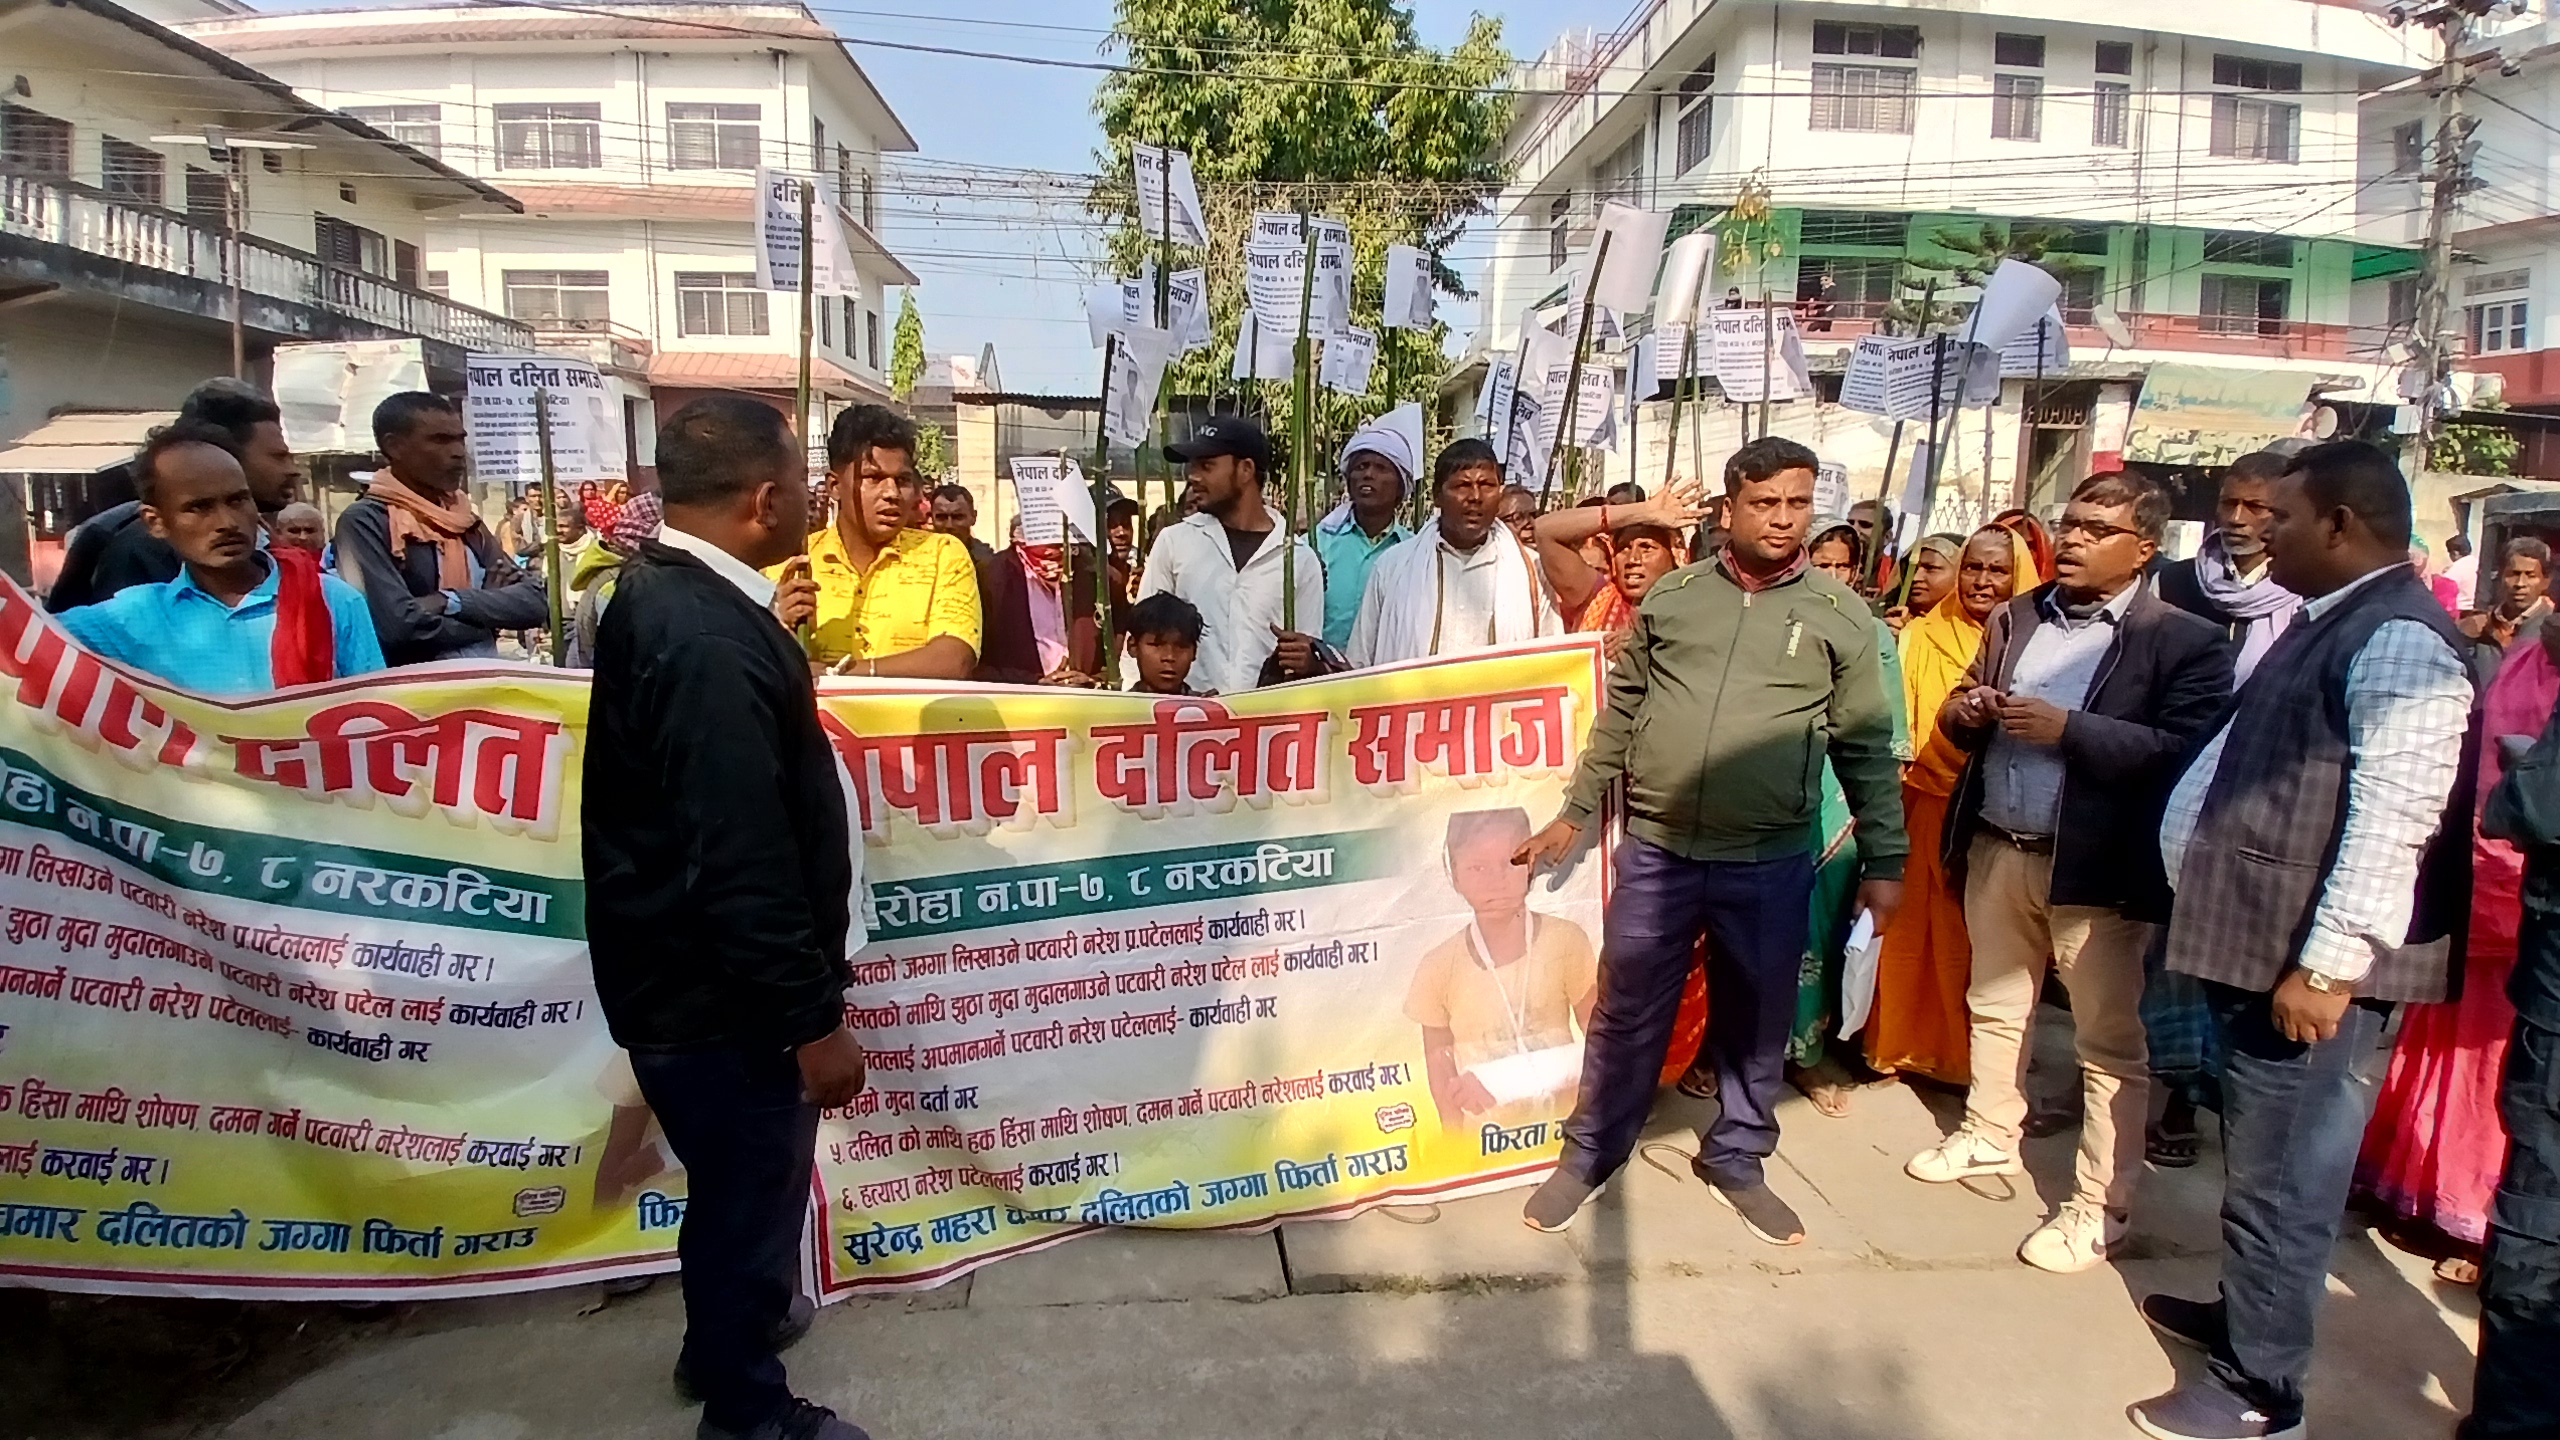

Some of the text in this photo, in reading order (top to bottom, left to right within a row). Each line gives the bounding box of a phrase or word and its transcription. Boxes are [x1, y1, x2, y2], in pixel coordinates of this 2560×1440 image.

[1248, 249, 1279, 269] नेपाल
[1259, 218, 1288, 236] नेपाल
[1714, 316, 1741, 334] नेपाल
[1887, 344, 1919, 364] नेपाल
[508, 362, 560, 387] दलित
[1016, 463, 1048, 481] नेपाल
[216, 701, 561, 821] दलित
[1090, 699, 1329, 806] दलित
[1347, 686, 1568, 785] समाज
[26, 843, 114, 894] लिखाउने
[120, 878, 177, 920] पटवारी
[182, 905, 227, 941] नरेश
[351, 939, 445, 979] कार्यवाही
[447, 952, 483, 982] गर
[260, 856, 297, 889] ८
[311, 860, 552, 924] नरकटिया
[875, 886, 963, 927] रोहा
[1128, 866, 1150, 897] ८
[1163, 844, 1335, 891] नरकटिया
[6, 907, 54, 944] झुठा
[56, 916, 101, 952] मुदा
[105, 923, 213, 972] मुदालगाउने
[219, 959, 283, 998] पटवारी
[288, 980, 338, 1011] नरेश
[344, 988, 396, 1019] पटेल
[401, 996, 445, 1025] लाई
[449, 999, 537, 1029] कार्यवाही
[541, 1000, 570, 1024] गर
[902, 953, 947, 980] जग्गा
[952, 939, 1020, 973] लिखाउने
[1025, 930, 1078, 961] पटवारी
[1082, 927, 1120, 955] नरेश
[1208, 908, 1269, 940] कार्यवाही
[1274, 909, 1296, 932] गर
[70, 976, 145, 1012] पटवारी
[149, 982, 203, 1019] नरेश
[307, 1026, 393, 1062] कार्यवाही
[397, 1039, 432, 1062] गर
[844, 1000, 901, 1030] लितको
[906, 993, 946, 1025] माथि
[951, 993, 983, 1024] झुठा
[988, 988, 1019, 1018] मुदा
[1024, 971, 1110, 1013] मुदालगाउने
[1115, 963, 1165, 995] पटवारी
[1170, 960, 1207, 987] नरेश
[1212, 955, 1246, 983] पटेल
[1250, 948, 1280, 979] लाई
[1284, 939, 1343, 972] कार्यवाही
[1347, 942, 1369, 965] गर
[921, 1029, 1006, 1071] अपमानगर्ने
[1011, 1020, 1063, 1053] पटवारी
[1068, 1016, 1106, 1044] नरेश
[1189, 995, 1250, 1028] कार्यवाही
[1256, 996, 1277, 1018] गर
[18, 1078, 72, 1120] हिंसा
[75, 1087, 131, 1124] माथि
[209, 1105, 263, 1134] दमन
[266, 1108, 302, 1140] गर्ने
[304, 1118, 373, 1153] पटवारी
[374, 1124, 468, 1167] नरेशलाई
[466, 1136, 536, 1171] करवाई
[537, 1144, 570, 1168] गर
[846, 1130, 893, 1162] दलित
[898, 1125, 920, 1152] को
[925, 1125, 963, 1151] माथि
[967, 1128, 995, 1154] हक
[1000, 1117, 1035, 1149] हिंसा
[1040, 1107, 1079, 1139] माथि
[1136, 1098, 1173, 1125] दमन
[1178, 1089, 1203, 1118] गर्ने
[1208, 1081, 1257, 1113] पटवारी
[1261, 1070, 1324, 1105] नरेशलाई
[1328, 1062, 1375, 1095] करवाई
[1379, 1065, 1401, 1086] गर
[884, 1090, 915, 1117] मुदा
[919, 1084, 949, 1113] दर्ता
[954, 1085, 979, 1109] गर
[41, 1147, 118, 1187] करवाई
[121, 1156, 157, 1186] गर
[1481, 1123, 1548, 1157] फिरता
[843, 1221, 924, 1266] सुरेन्द्र
[928, 1206, 996, 1245] महरा
[1080, 1181, 1190, 1224] दलितको
[1198, 1172, 1268, 1208] जग्गा
[1275, 1153, 1339, 1193] फिर्ता
[1345, 1144, 1408, 1178] गराउ
[858, 1178, 910, 1209] हत्यारा
[914, 1166, 953, 1195] नरेश
[958, 1163, 1024, 1194] पटेललाई
[1028, 1152, 1081, 1187] करवाई
[1086, 1153, 1109, 1177] गर
[96, 1201, 250, 1250] दलितको
[258, 1219, 353, 1253] जग्गा
[363, 1218, 444, 1259] फिर्ता
[454, 1226, 539, 1257] गराउ
